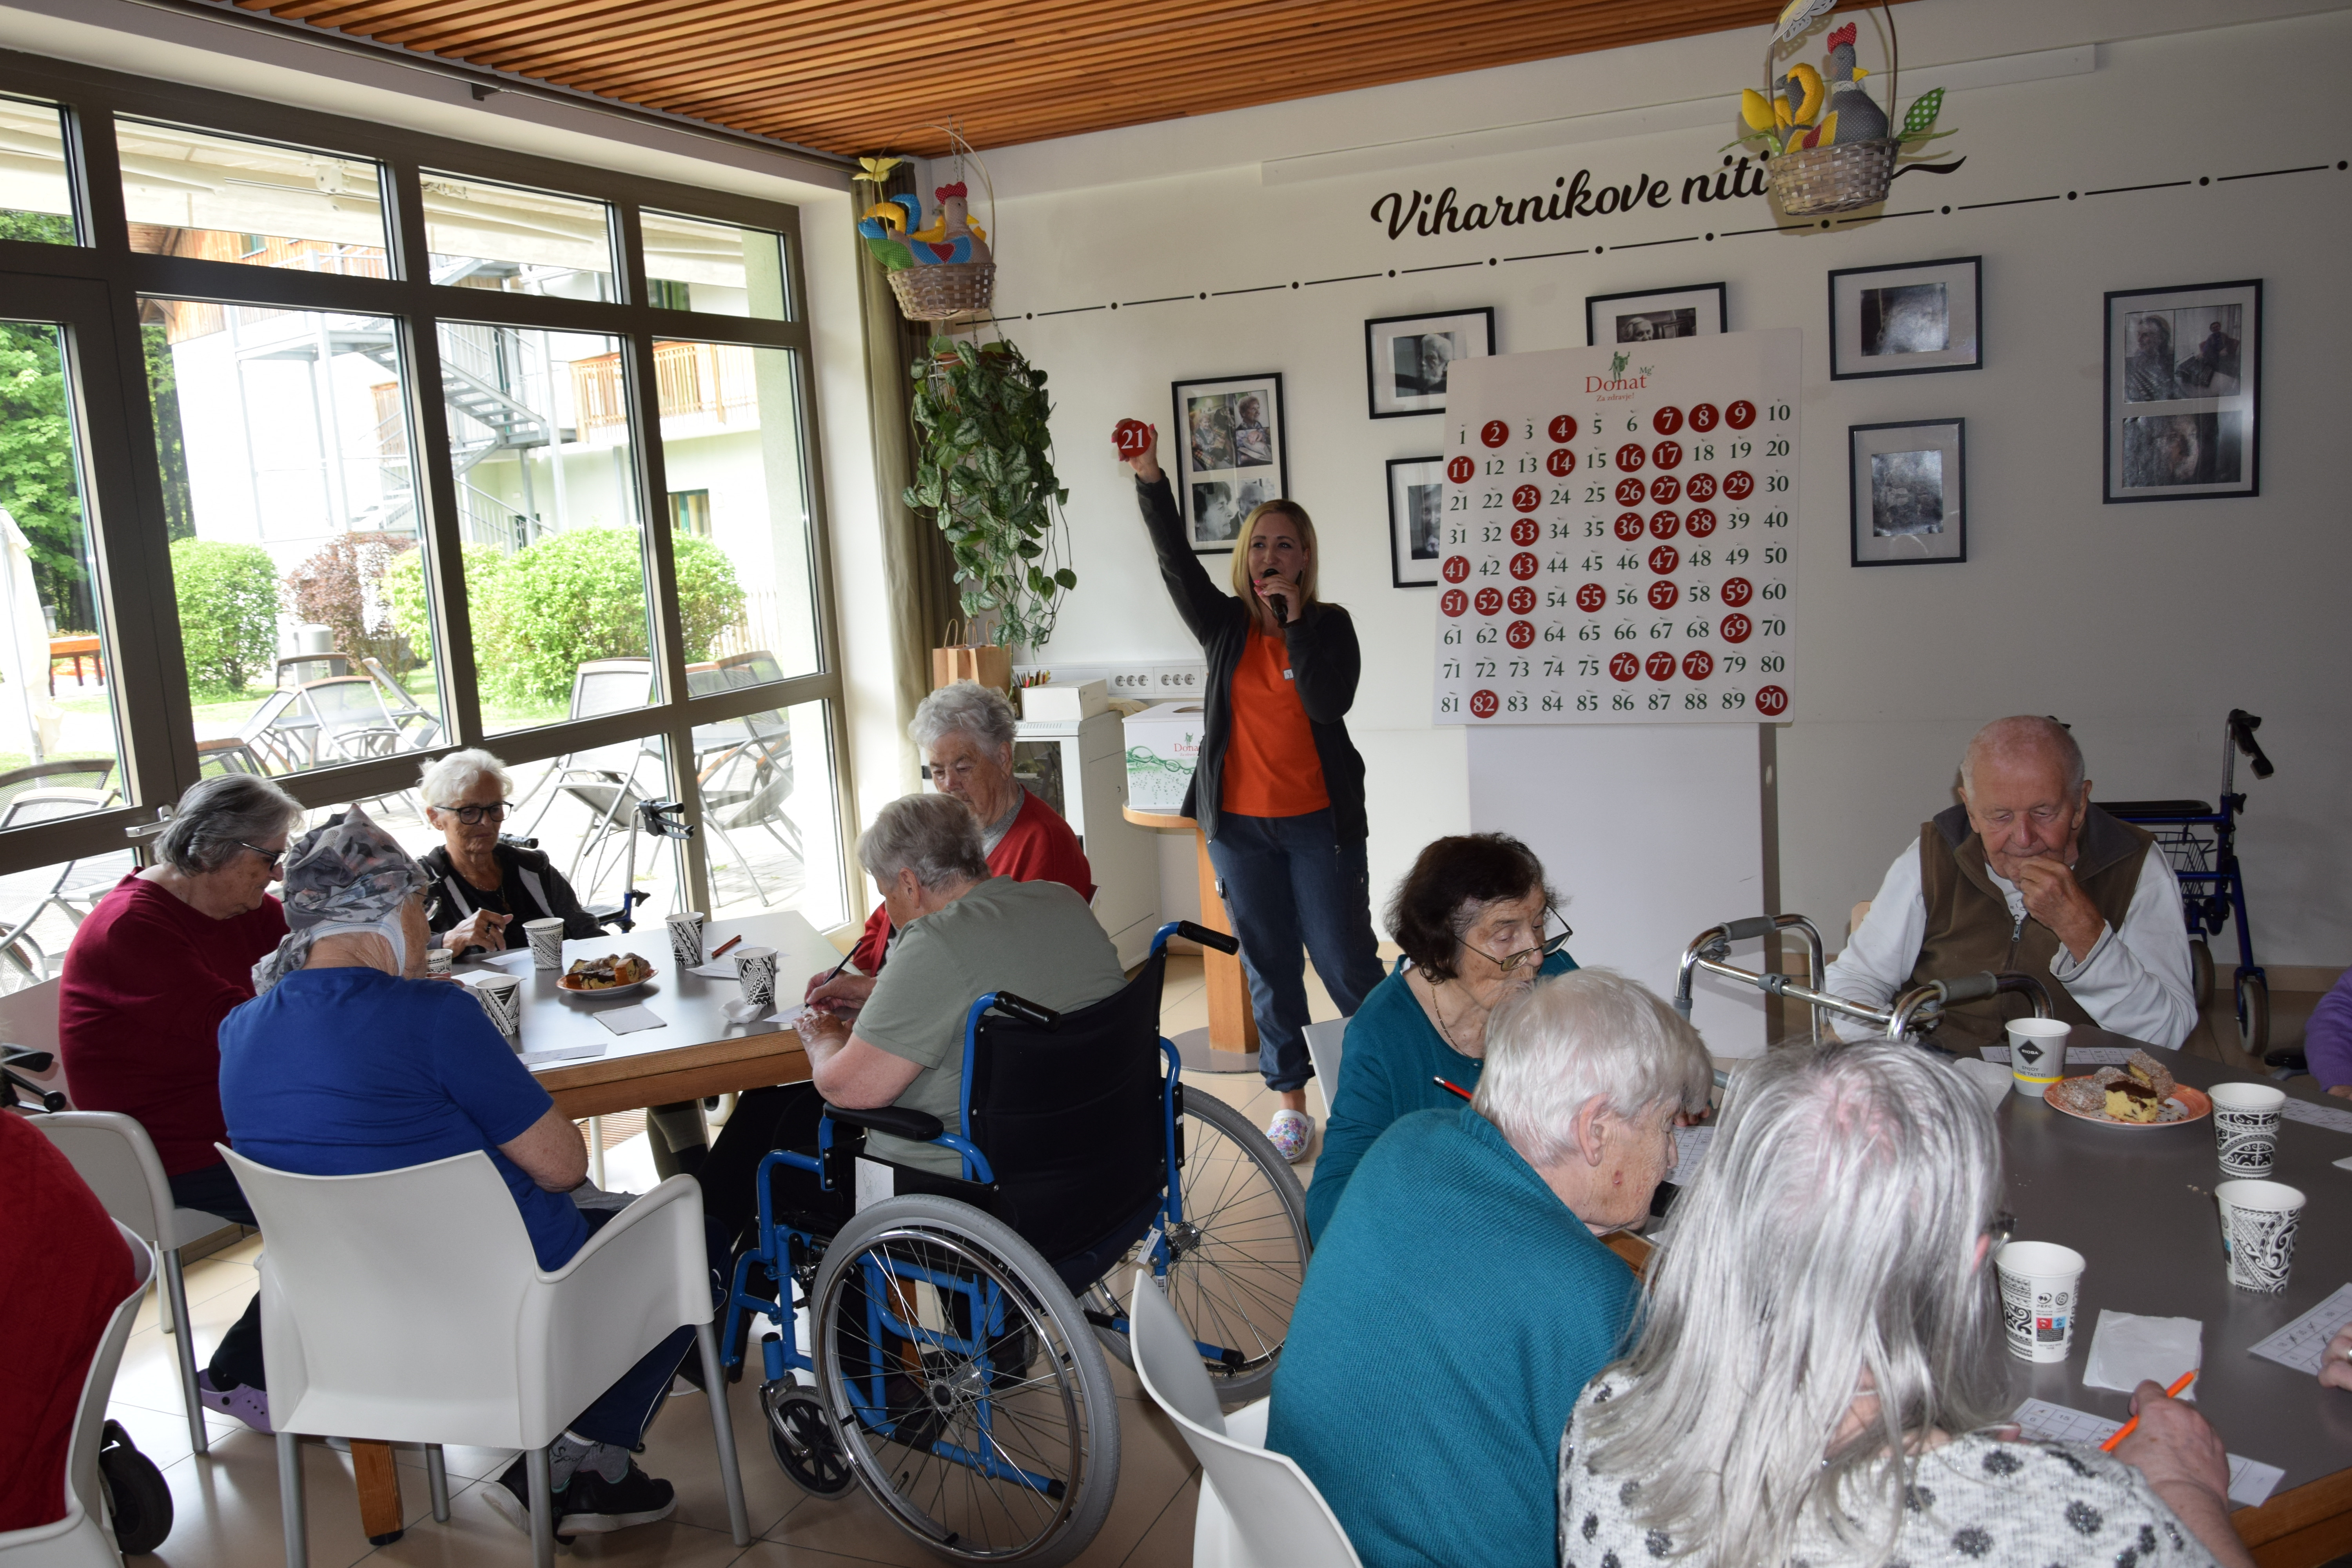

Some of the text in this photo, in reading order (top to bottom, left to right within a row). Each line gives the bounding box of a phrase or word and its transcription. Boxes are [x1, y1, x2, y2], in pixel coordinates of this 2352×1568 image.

[1370, 150, 1769, 240] Viharnikove niti
[1585, 374, 1647, 393] Donat
[1607, 392, 1634, 401] zdravje!
[1121, 428, 1144, 449] 21
[1460, 405, 1790, 445] 1 2 3 4 5 6 7 8 9 10
[1452, 440, 1789, 478] 11 12 13 14 15 16 17 18 19 20
[1450, 475, 1789, 511] 21 22 23 24 25 26 27 28 29 30
[1450, 512, 1788, 544] 31 32 33 34 35 36 37 38 39 40
[1445, 547, 1787, 577] 41 42 43 44 45 46 47 48 49 50
[1444, 583, 1786, 611] 51 52 53 54 55 56 57 58 59 60
[1444, 619, 1786, 645] 61 62 63 64 65 66 67 68 69 70
[1443, 656, 1785, 679] 71 72 73 74 75 76 77 78 79 80
[1441, 692, 1784, 712] 81 82 83 84 85 86 87 88 89 90
[1174, 743, 1200, 752] Dona
